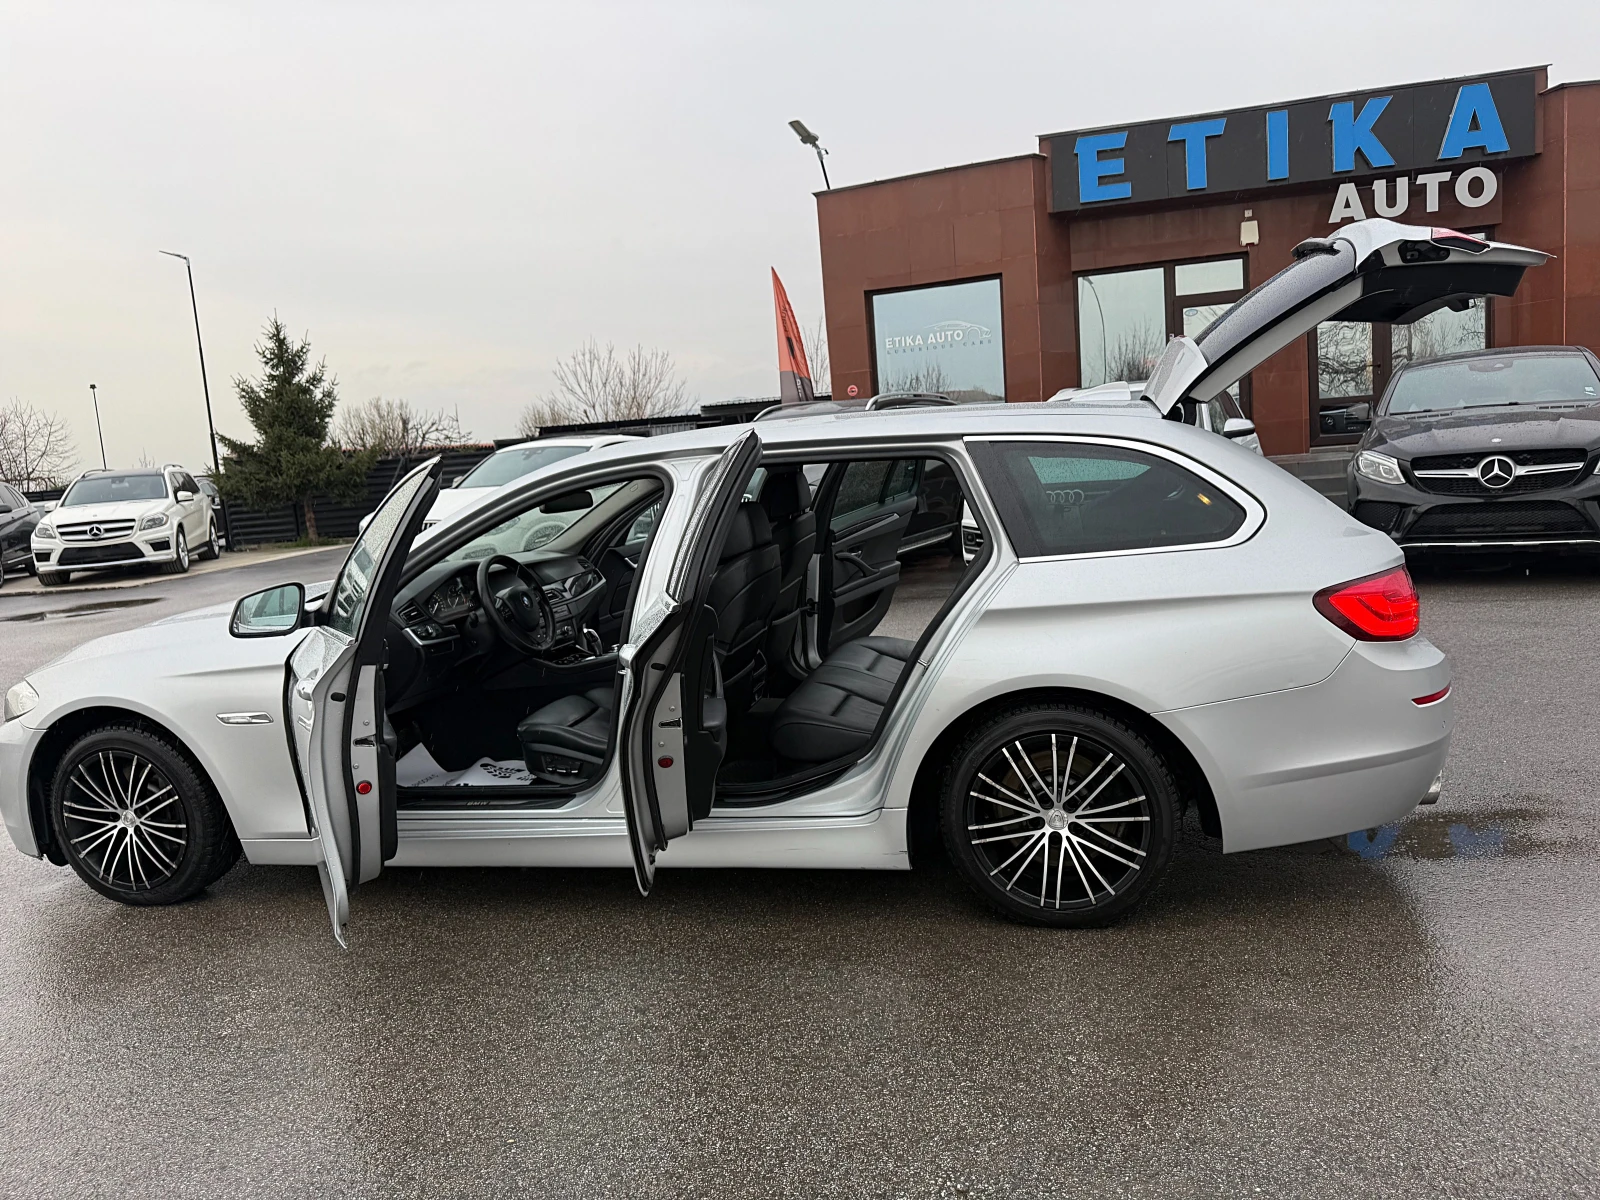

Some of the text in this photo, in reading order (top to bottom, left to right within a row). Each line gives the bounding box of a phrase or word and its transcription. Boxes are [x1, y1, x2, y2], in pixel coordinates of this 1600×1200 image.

[1073, 82, 1511, 204] ETIKA
[1328, 167, 1498, 224] AUTO
[885, 330, 964, 348] ETIKA AUTO
